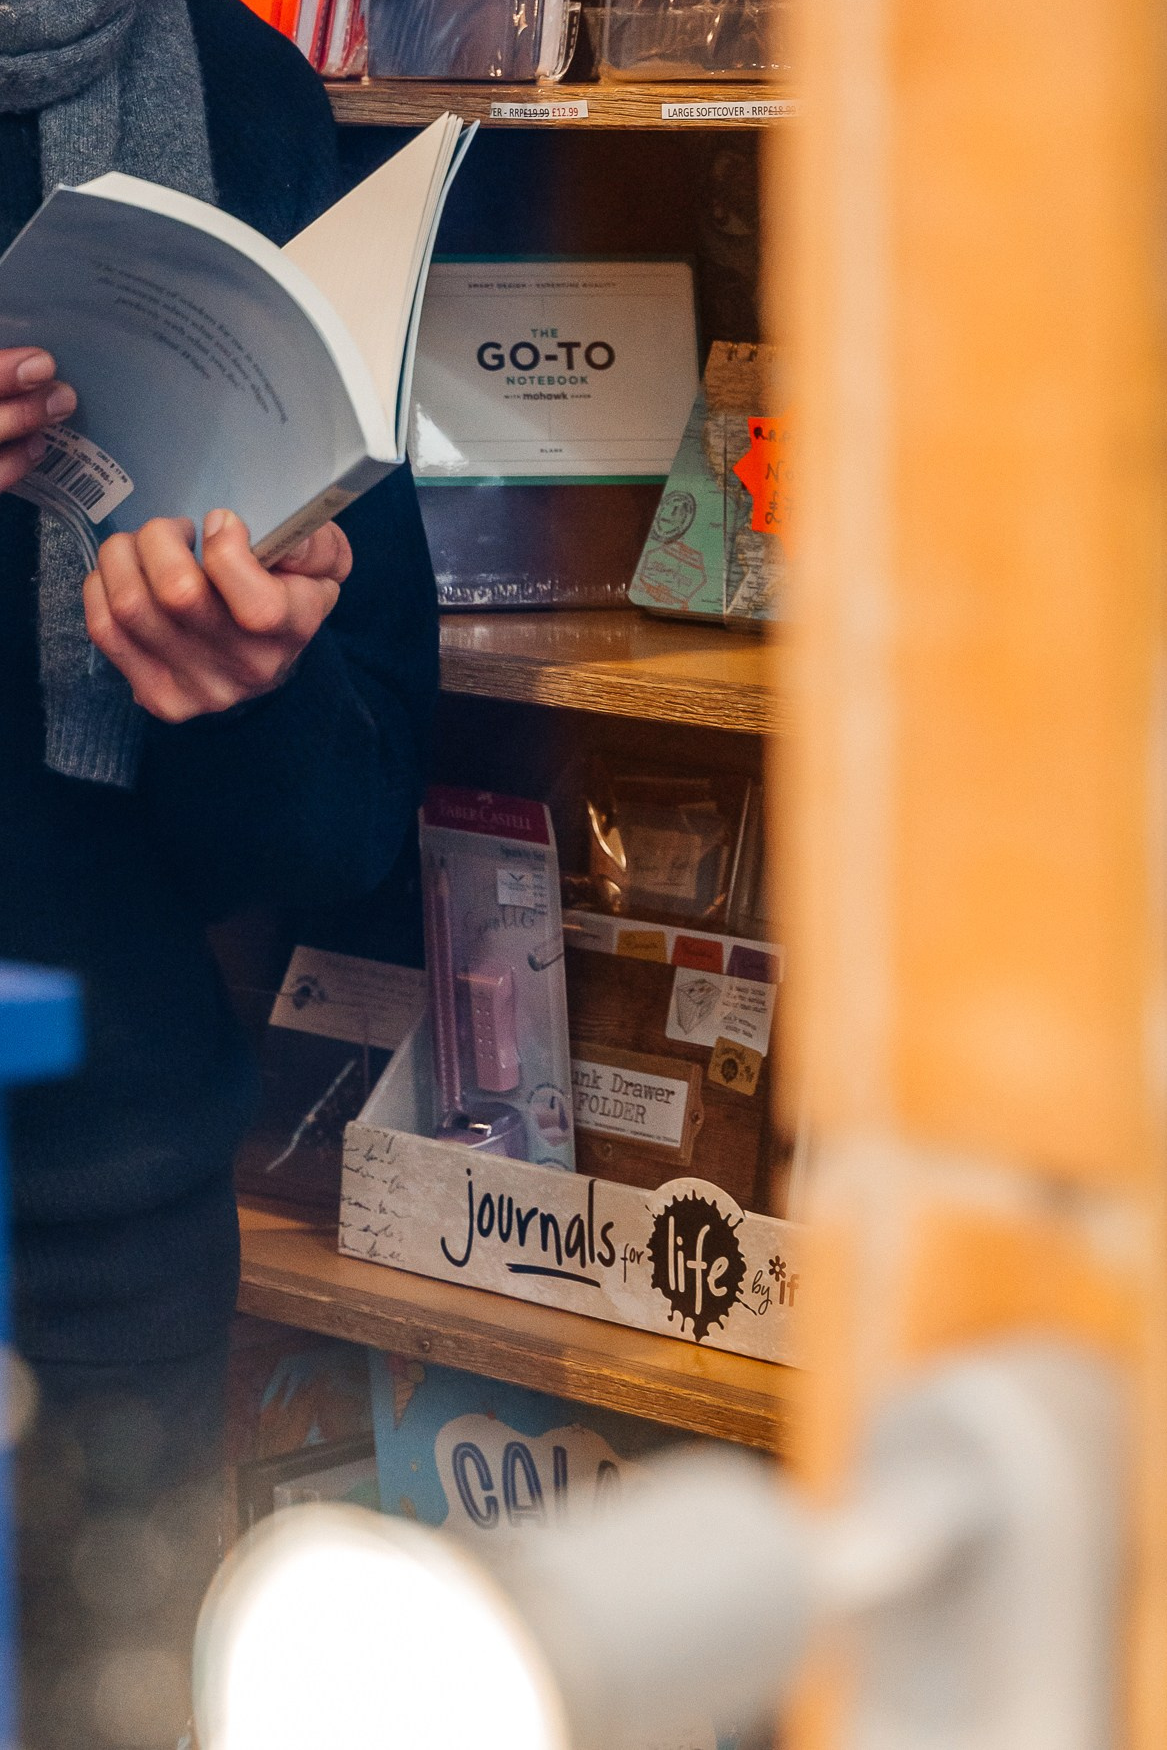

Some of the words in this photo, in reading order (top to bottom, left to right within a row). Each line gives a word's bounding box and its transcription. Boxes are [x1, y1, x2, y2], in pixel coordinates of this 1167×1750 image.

[552, 107, 579, 117] £12.99
[668, 107, 694, 118] LARGE
[696, 106, 745, 117] SOFTCOVER
[531, 328, 558, 338] THE
[477, 341, 615, 371] GO-TO
[506, 376, 588, 386] NOTEBOOK
[523, 392, 568, 400] mohawk
[572, 1070, 603, 1090] unk
[610, 1073, 675, 1104] Drawer
[576, 1091, 647, 1125] FOLDER
[440, 1168, 616, 1269] journals
[620, 1243, 645, 1283] for
[667, 1216, 729, 1315] life
[751, 1270, 773, 1315] by
